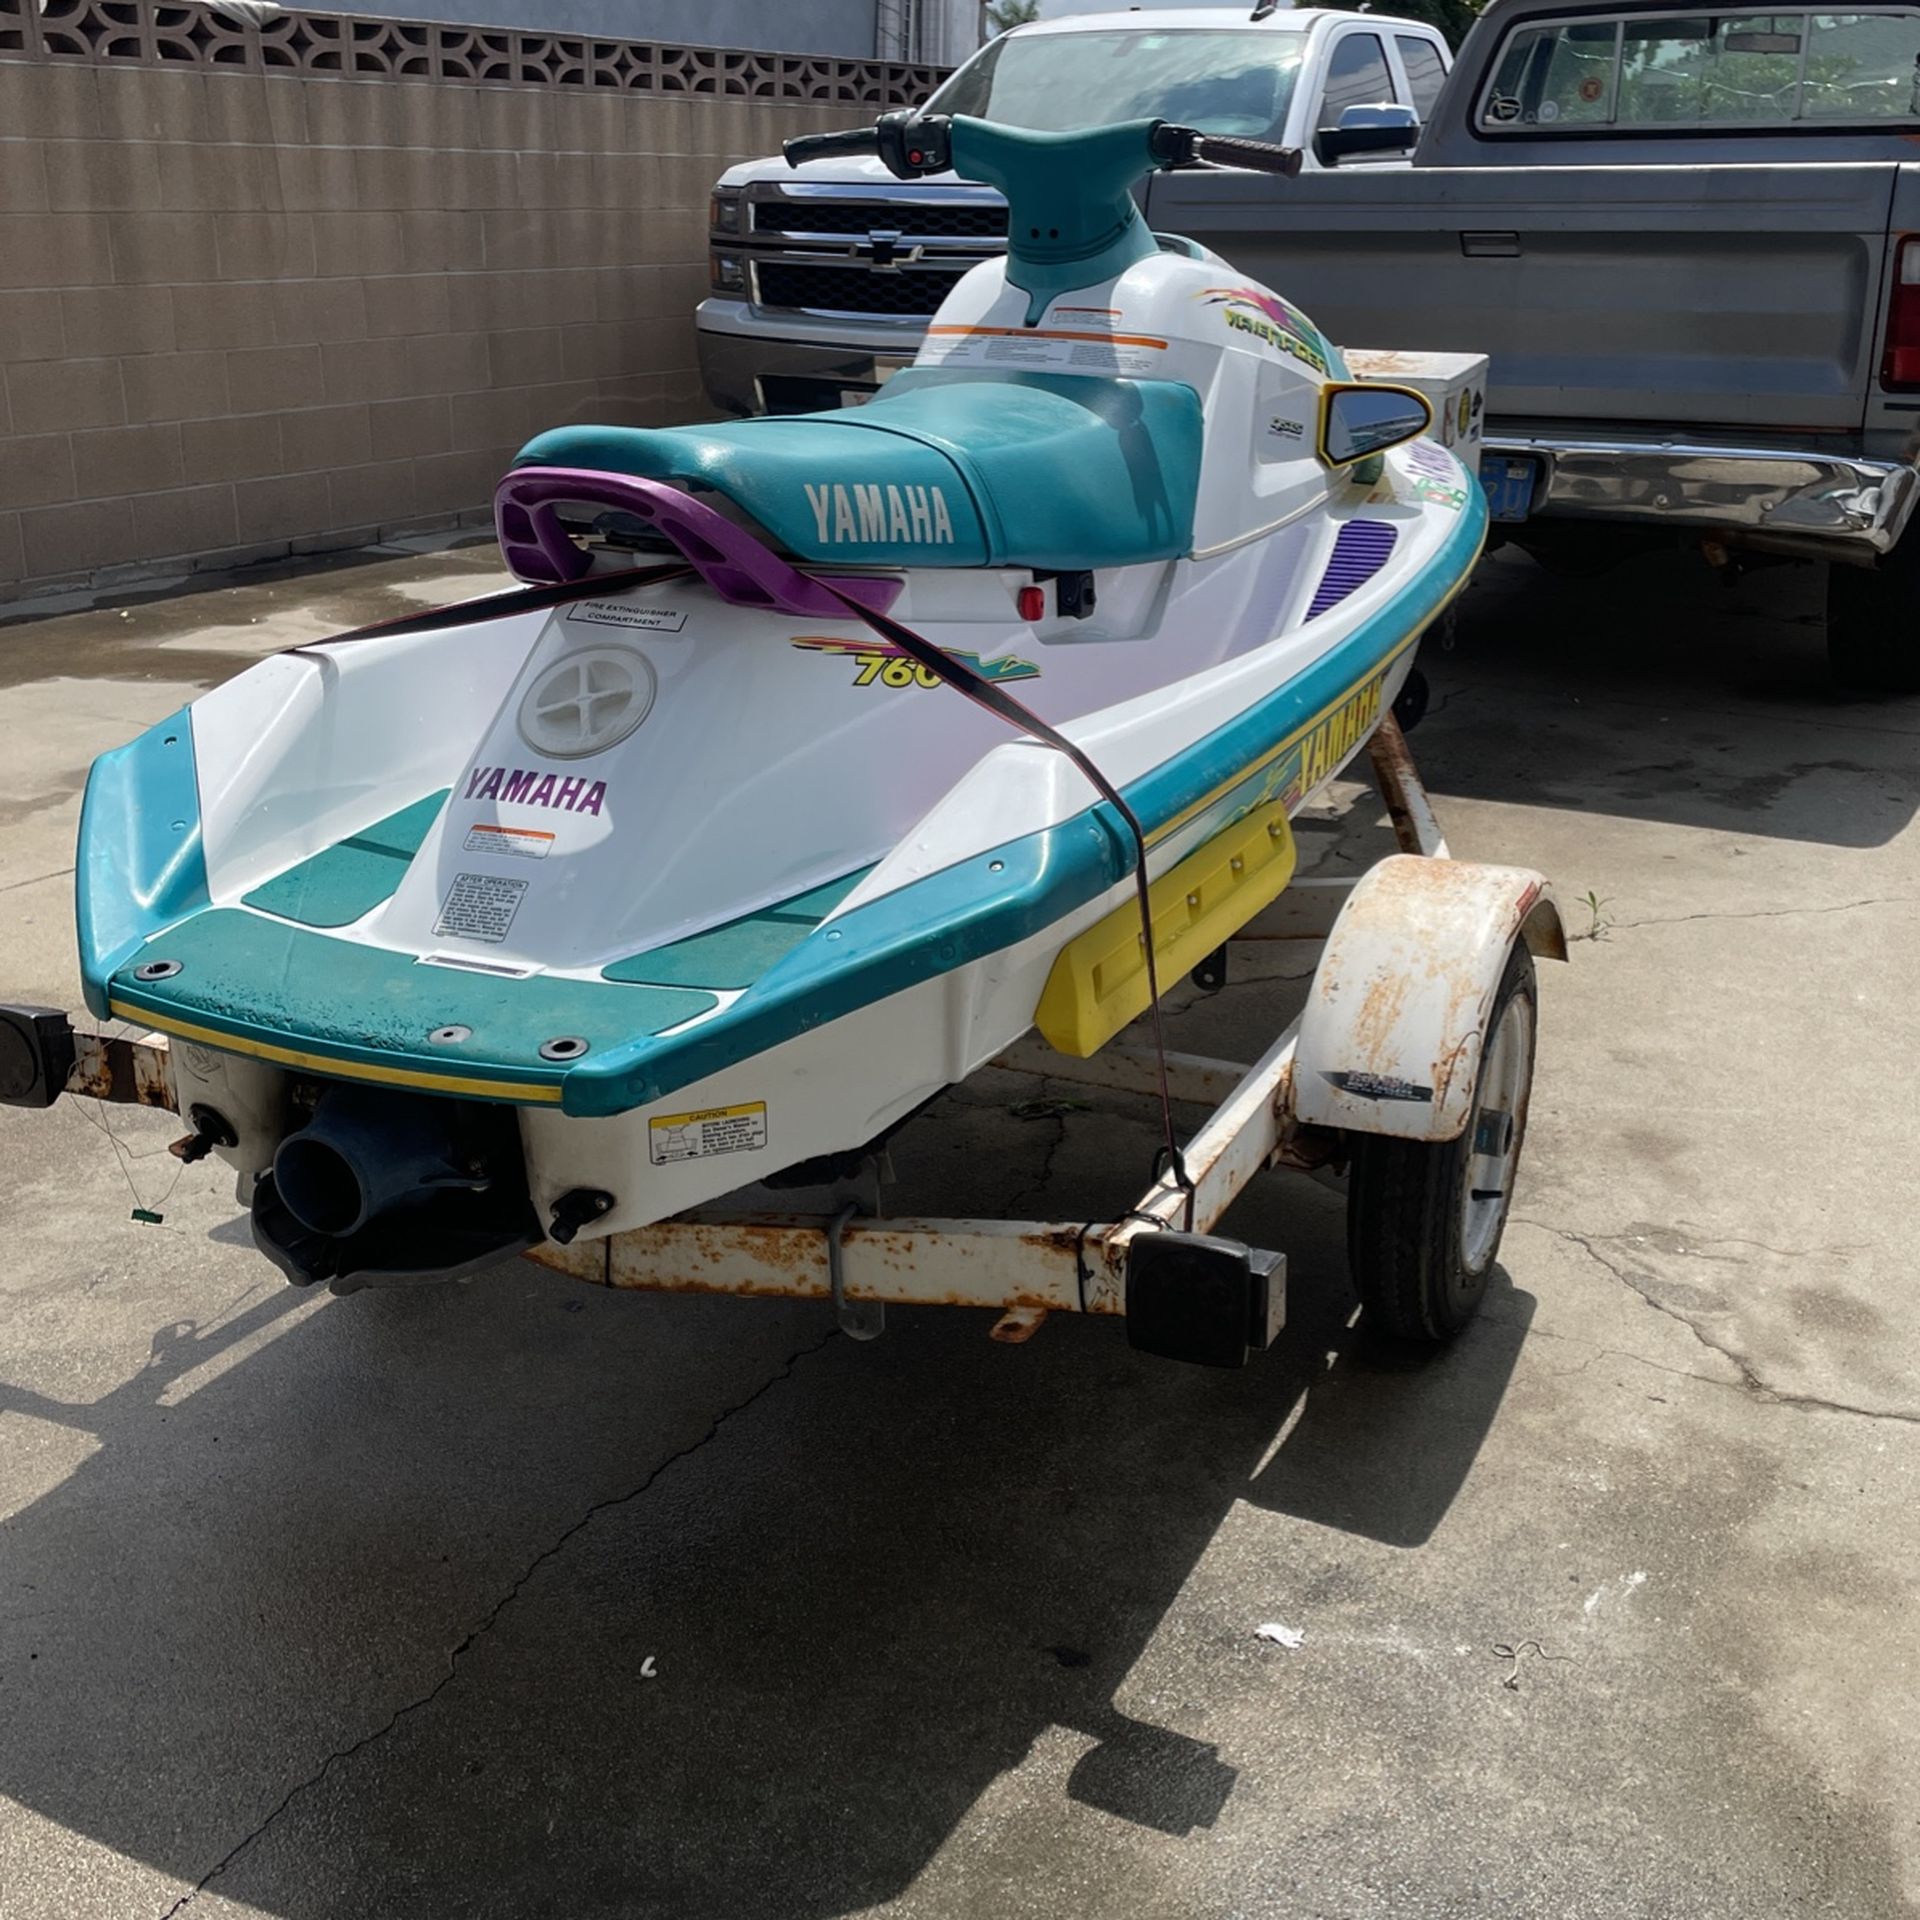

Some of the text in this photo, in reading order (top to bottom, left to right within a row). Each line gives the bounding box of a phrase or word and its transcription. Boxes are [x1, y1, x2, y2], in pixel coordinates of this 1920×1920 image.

[804, 484, 954, 544] YAMAHA
[584, 602, 677, 617] FIRE EXTINGUISHER
[588, 612, 661, 626] COMPARTMENT
[1301, 674, 1382, 798] YAMAHA
[464, 767, 607, 816] YAMAHA
[460, 875, 523, 888] AFTER OPERATION
[689, 1111, 728, 1122] CAUTION
